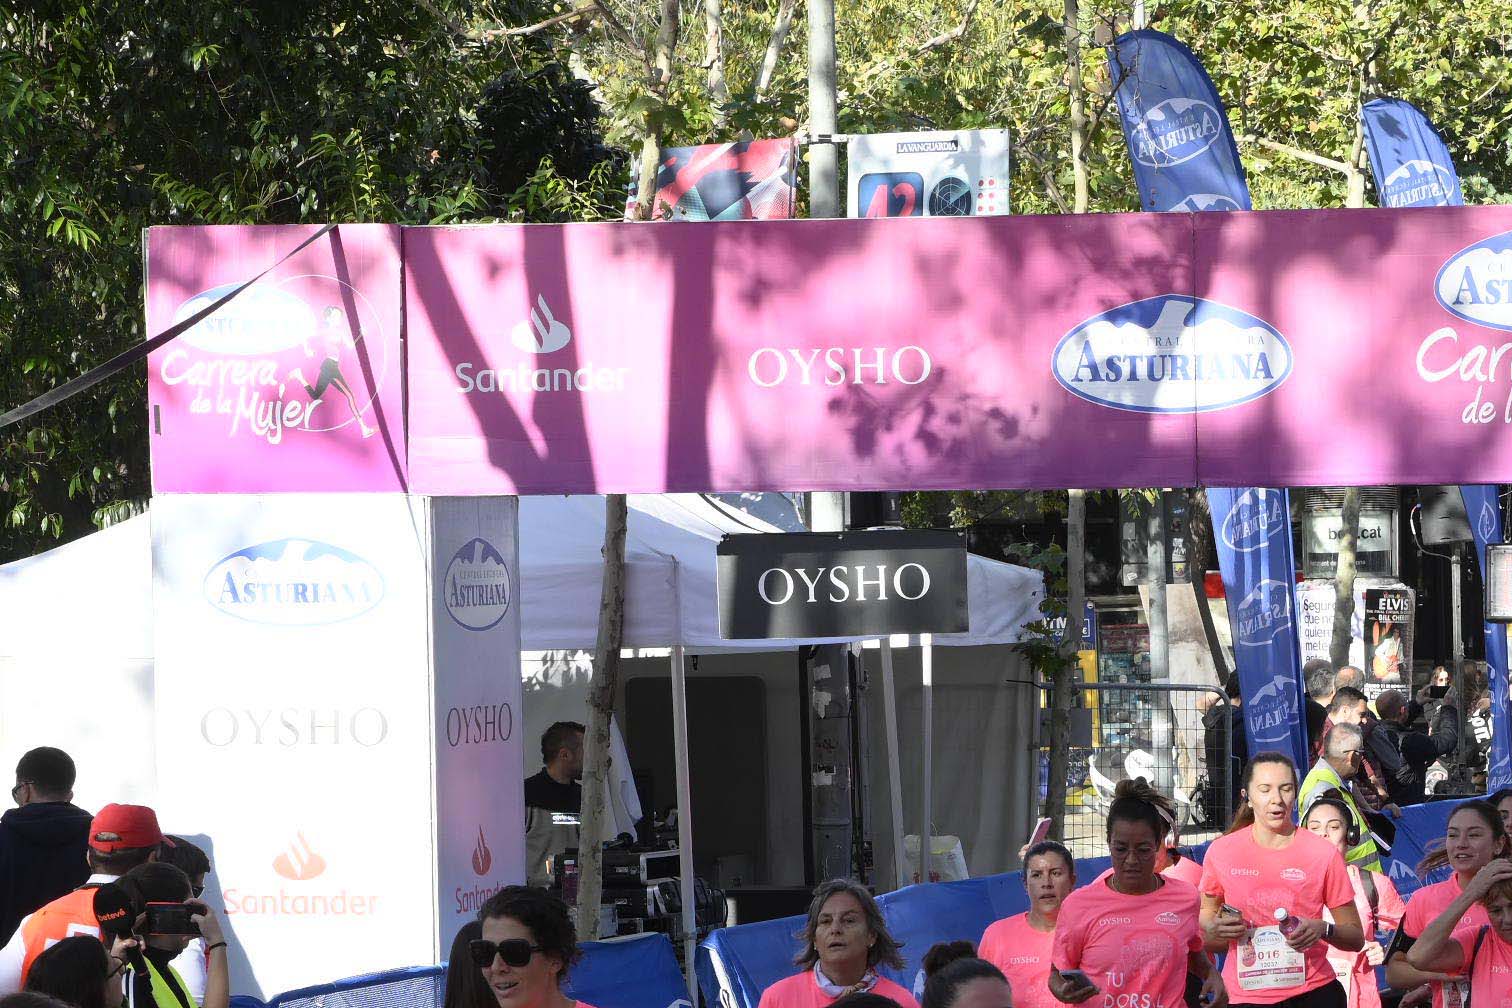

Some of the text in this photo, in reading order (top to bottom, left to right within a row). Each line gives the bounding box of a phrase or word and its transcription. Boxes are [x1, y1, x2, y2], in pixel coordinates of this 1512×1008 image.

[455, 361, 631, 394] Santander
[747, 345, 932, 388] OYSHO
[1462, 388, 1498, 426] de
[220, 571, 372, 604] ASTURIANA
[450, 573, 507, 608] ASTURIANA
[758, 562, 932, 607] OYSHO
[1379, 599, 1409, 611] ELVIS
[201, 706, 389, 749] OYSHO
[447, 702, 513, 748] OYSHO
[223, 886, 378, 917] Santander
[1257, 950, 1281, 961] 016
[1105, 971, 1125, 989] TU
